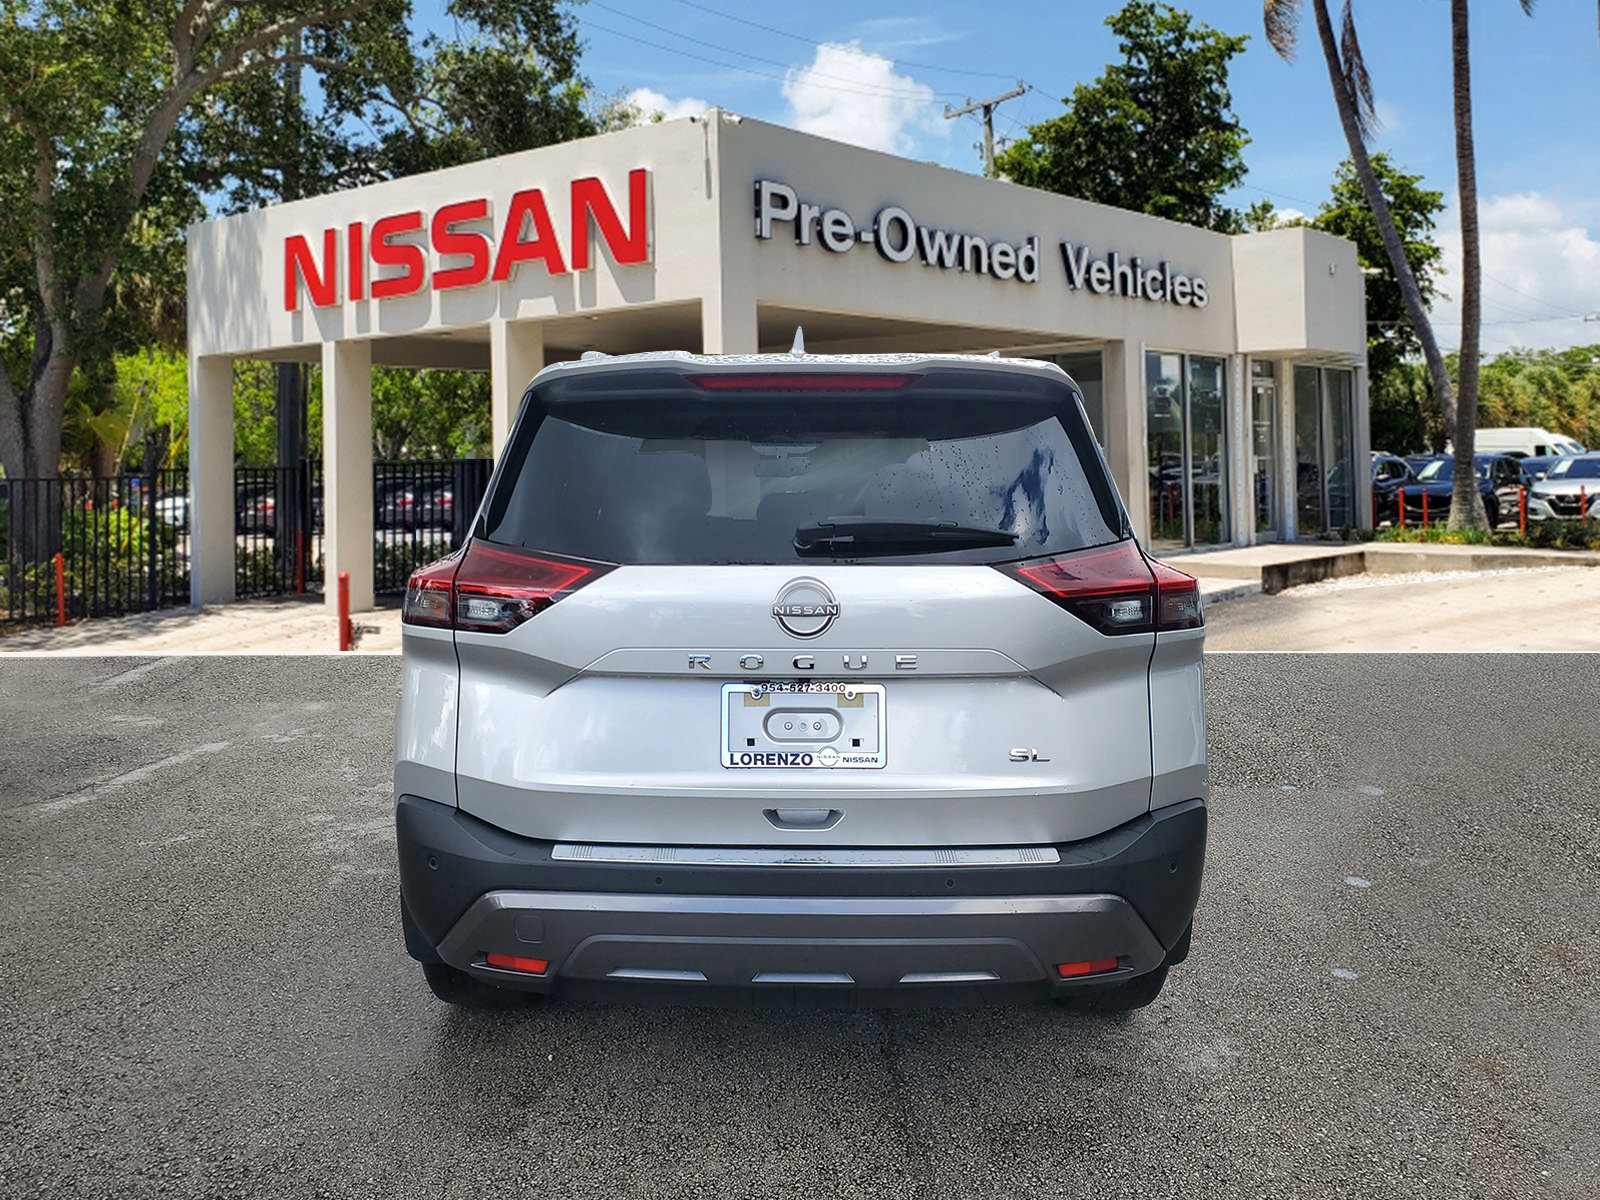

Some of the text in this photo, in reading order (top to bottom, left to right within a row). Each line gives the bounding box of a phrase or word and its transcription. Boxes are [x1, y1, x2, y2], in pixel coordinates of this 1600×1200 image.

[285, 168, 646, 311] NISSAN
[755, 180, 1209, 309] Pre-Owned Vehicles
[773, 604, 837, 615] NISSAN
[688, 654, 918, 670] ROGUE
[761, 683, 846, 693] 954-527-3400
[730, 753, 813, 766] LORENZO
[1009, 748, 1051, 762] SL
